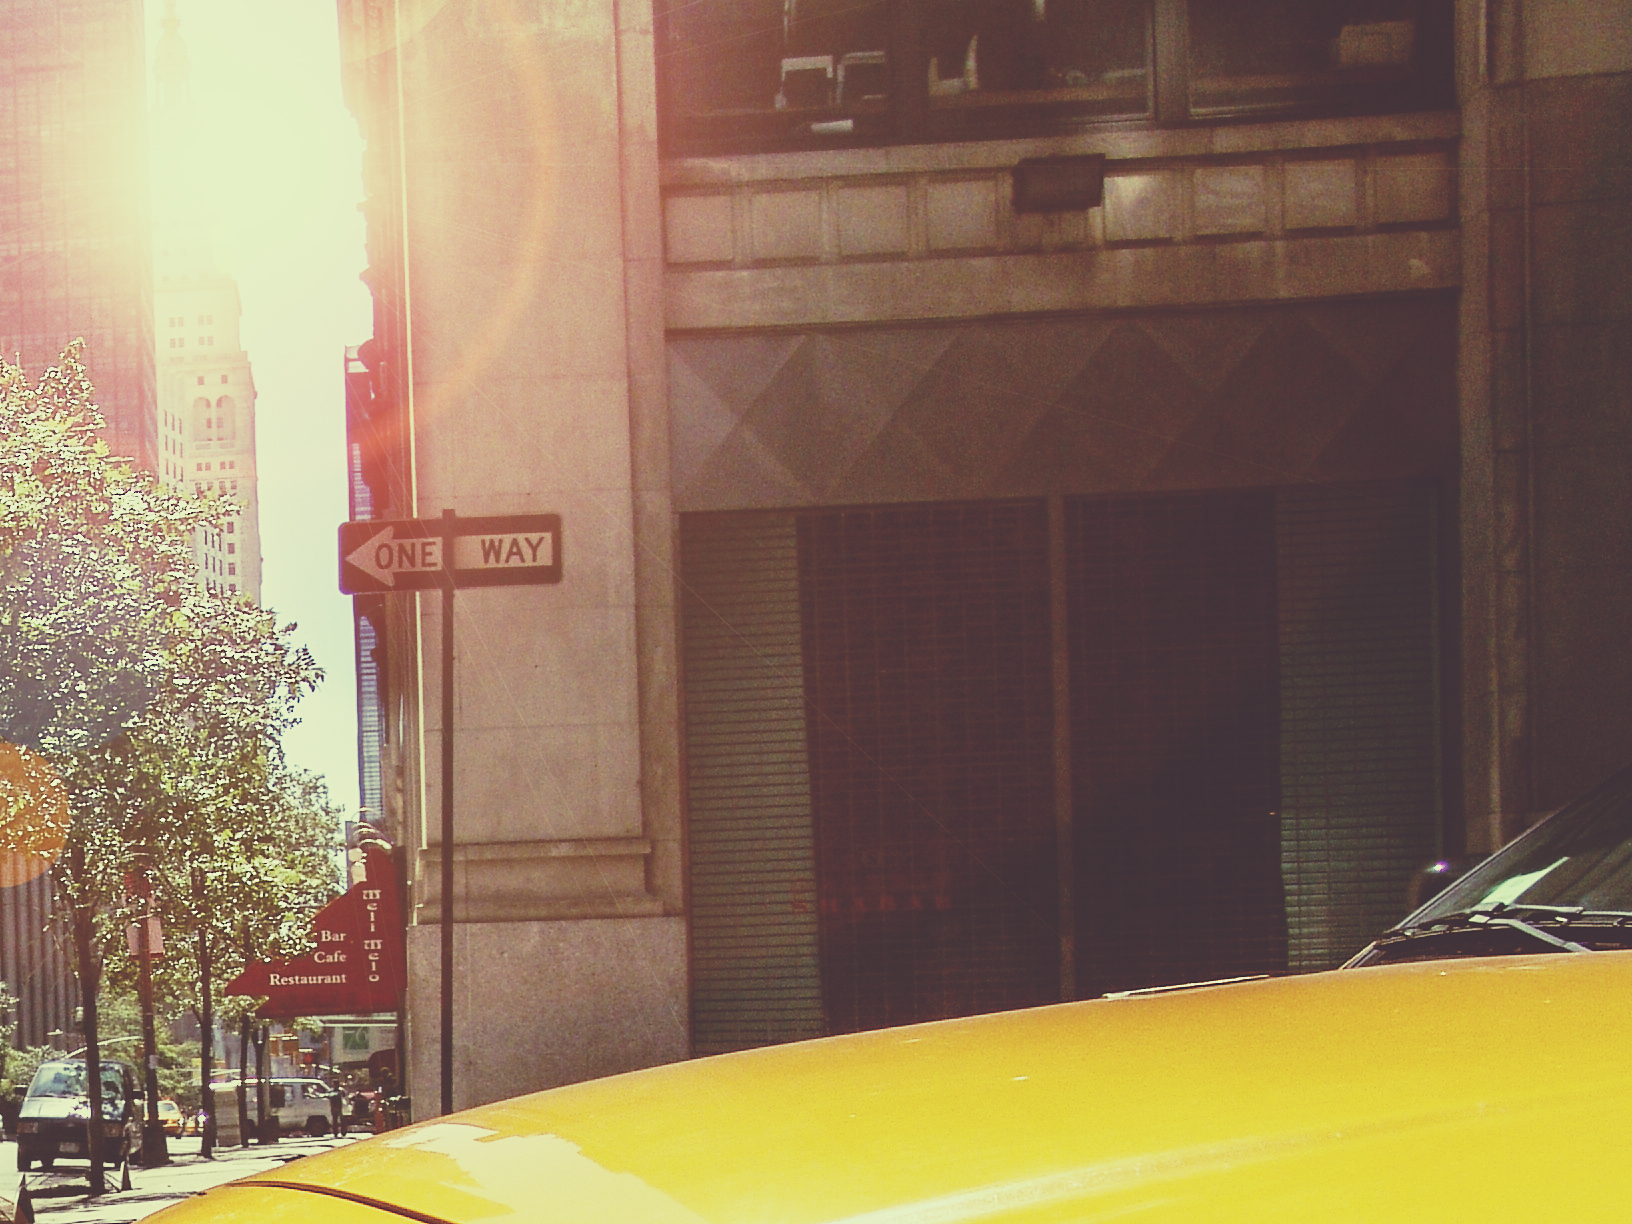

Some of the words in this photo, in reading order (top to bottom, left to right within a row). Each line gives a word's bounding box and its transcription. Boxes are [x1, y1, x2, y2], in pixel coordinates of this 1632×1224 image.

[374, 540, 438, 570] ONE
[480, 535, 545, 564] WAY
[321, 930, 347, 942] Bar
[313, 950, 347, 963] Cafe
[269, 973, 347, 986] Restaurant
